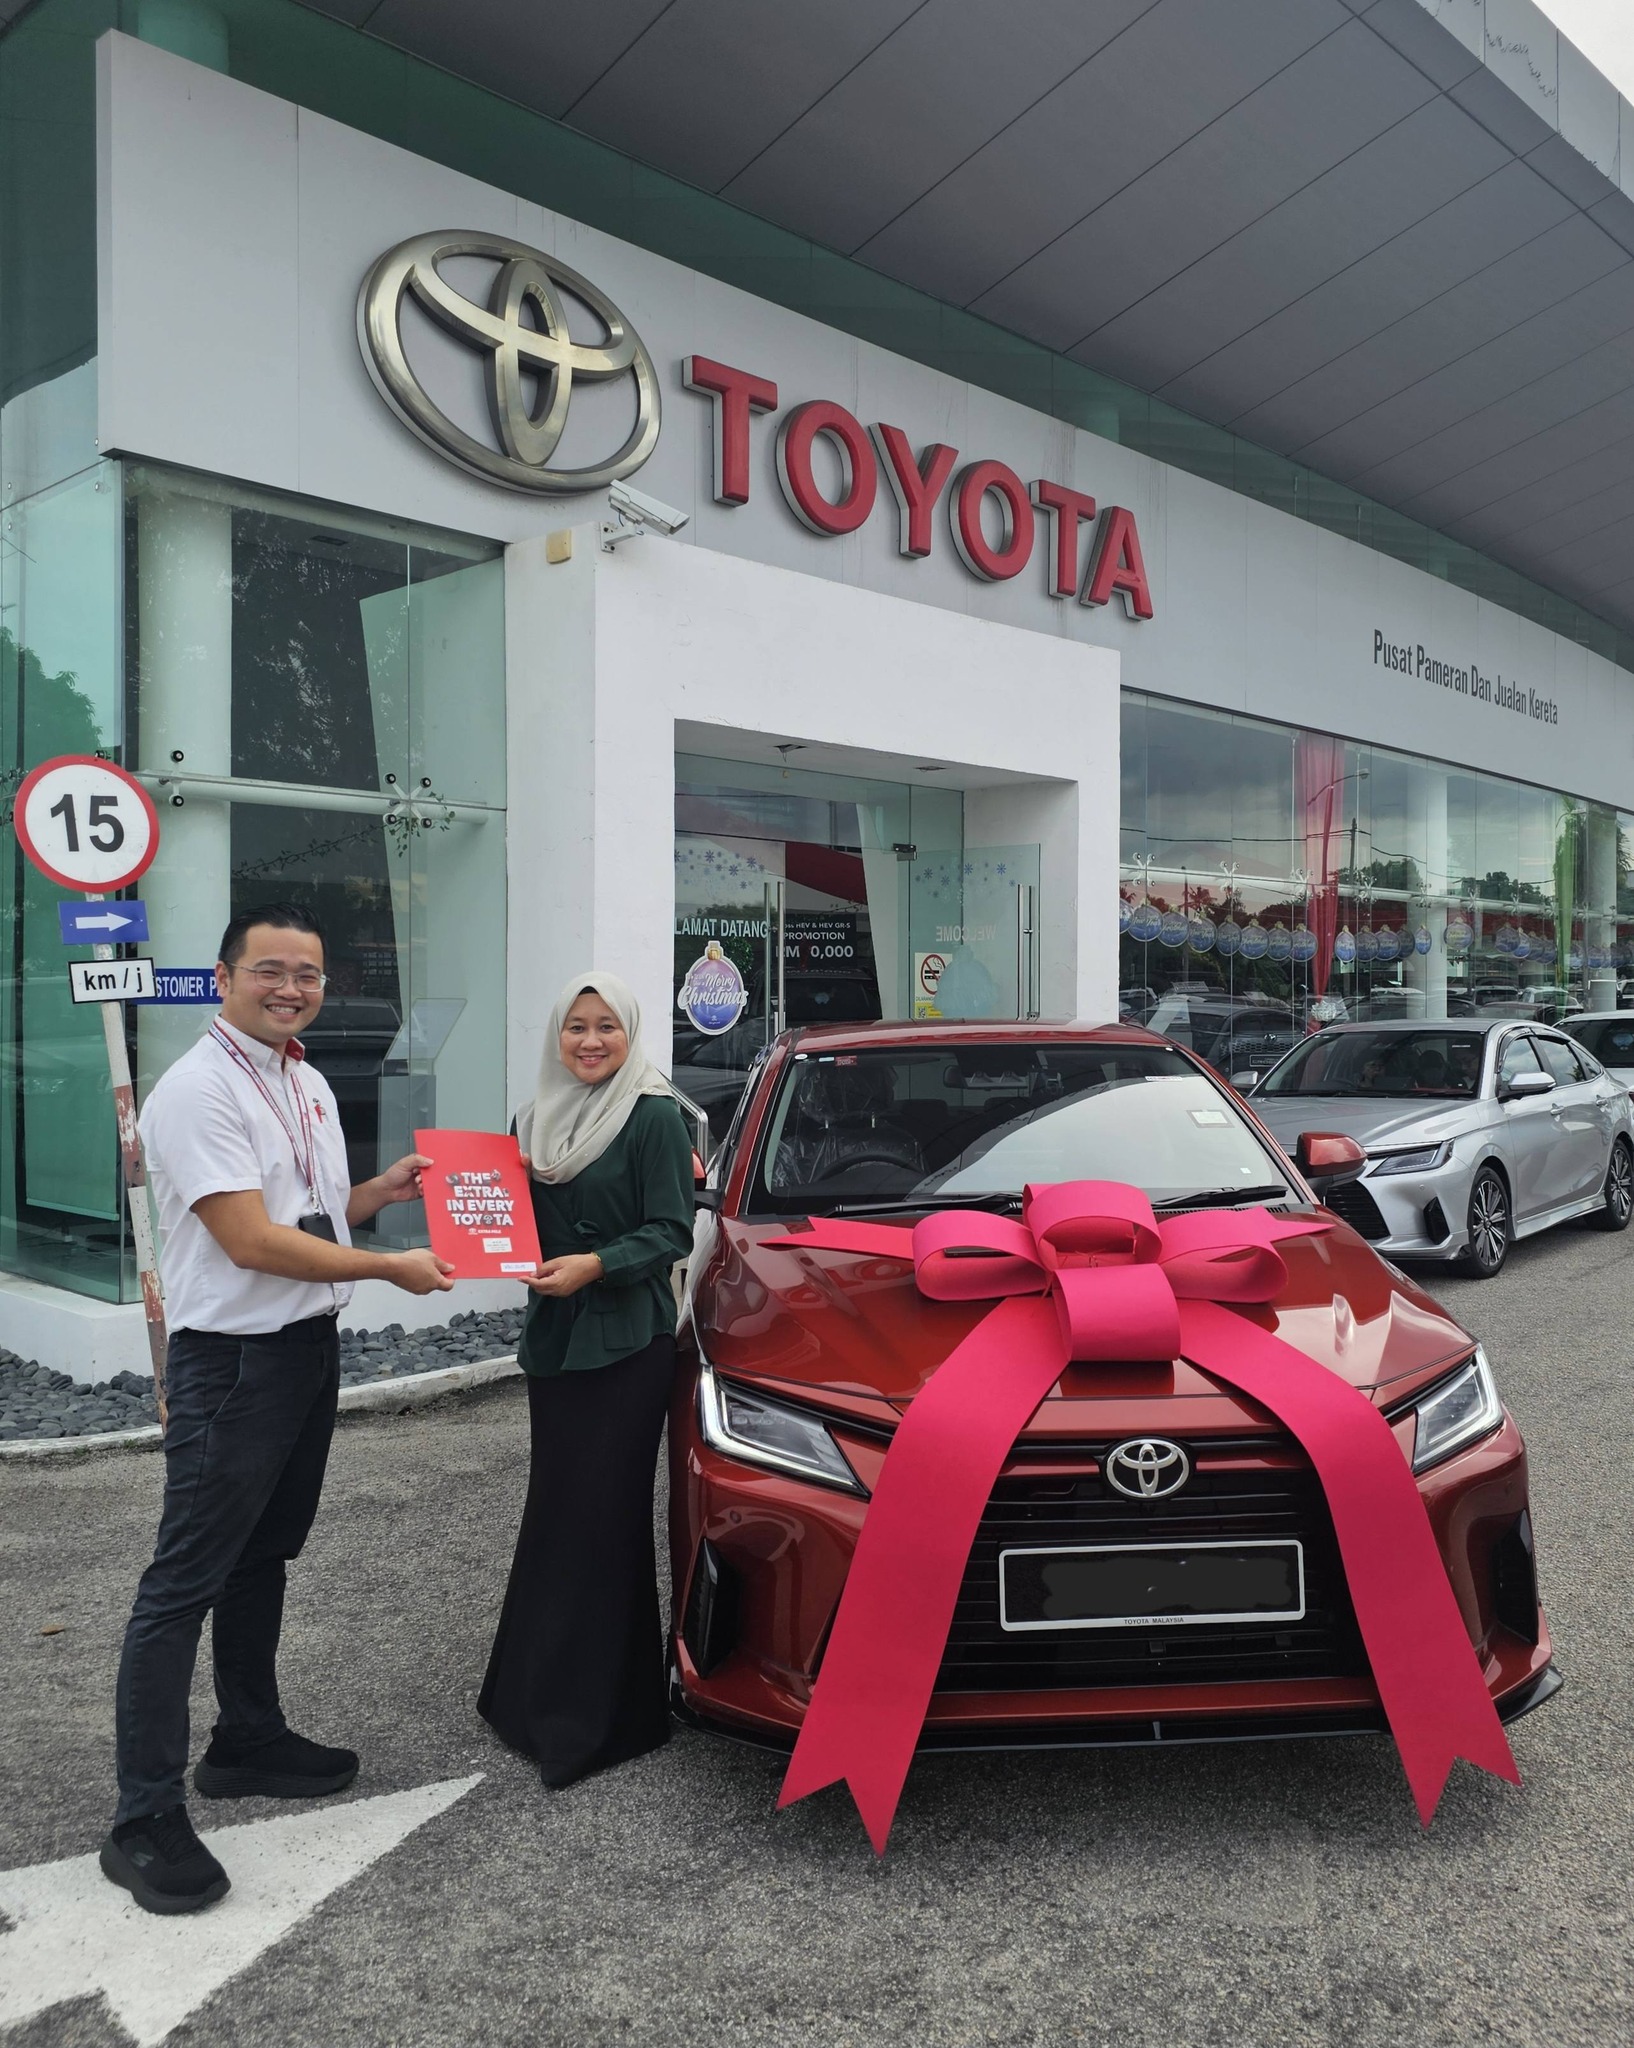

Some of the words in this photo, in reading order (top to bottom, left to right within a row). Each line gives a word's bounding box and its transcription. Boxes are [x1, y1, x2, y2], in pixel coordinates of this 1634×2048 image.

[681, 354, 1154, 622] TOYOTA
[1374, 629, 1412, 676] Pusat
[1416, 644, 1468, 695] Pameran
[1471, 665, 1492, 702] Dan
[1494, 674, 1527, 716] Jualan
[1529, 687, 1558, 725] Kereta
[50, 793, 125, 853] 15
[721, 919, 768, 939] DATANG
[783, 931, 845, 940] PROMOTION
[209, 976, 220, 997] P
[705, 973, 736, 991] Merry
[678, 985, 748, 1007] Christmas
[461, 1172, 491, 1185] THE
[453, 1185, 504, 1198] EXTRA
[446, 1199, 465, 1211] IN
[467, 1199, 514, 1212] EVERY
